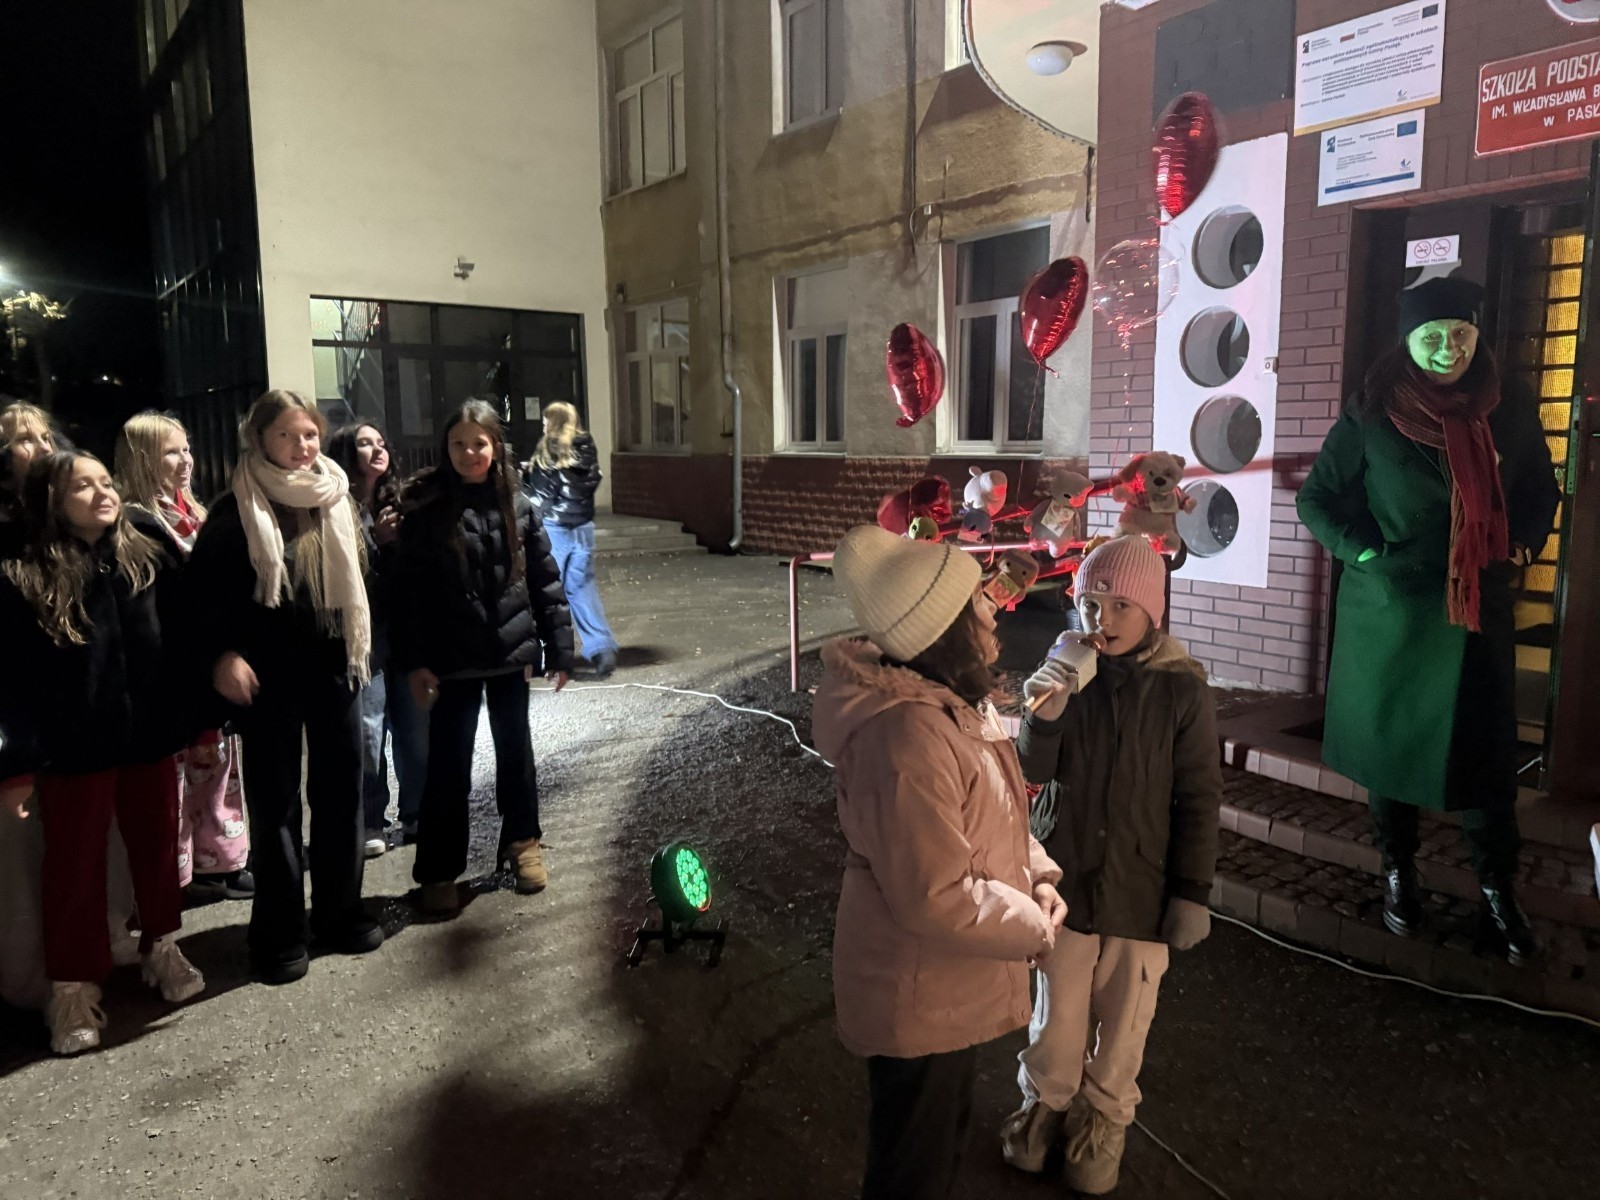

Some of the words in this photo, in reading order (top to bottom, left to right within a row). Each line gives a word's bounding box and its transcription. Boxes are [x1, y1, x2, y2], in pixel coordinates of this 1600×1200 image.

[1482, 65, 1536, 103] SZKOŁA
[1492, 105, 1507, 119] IM.
[1513, 87, 1586, 115] WŁADYSŁAWA
